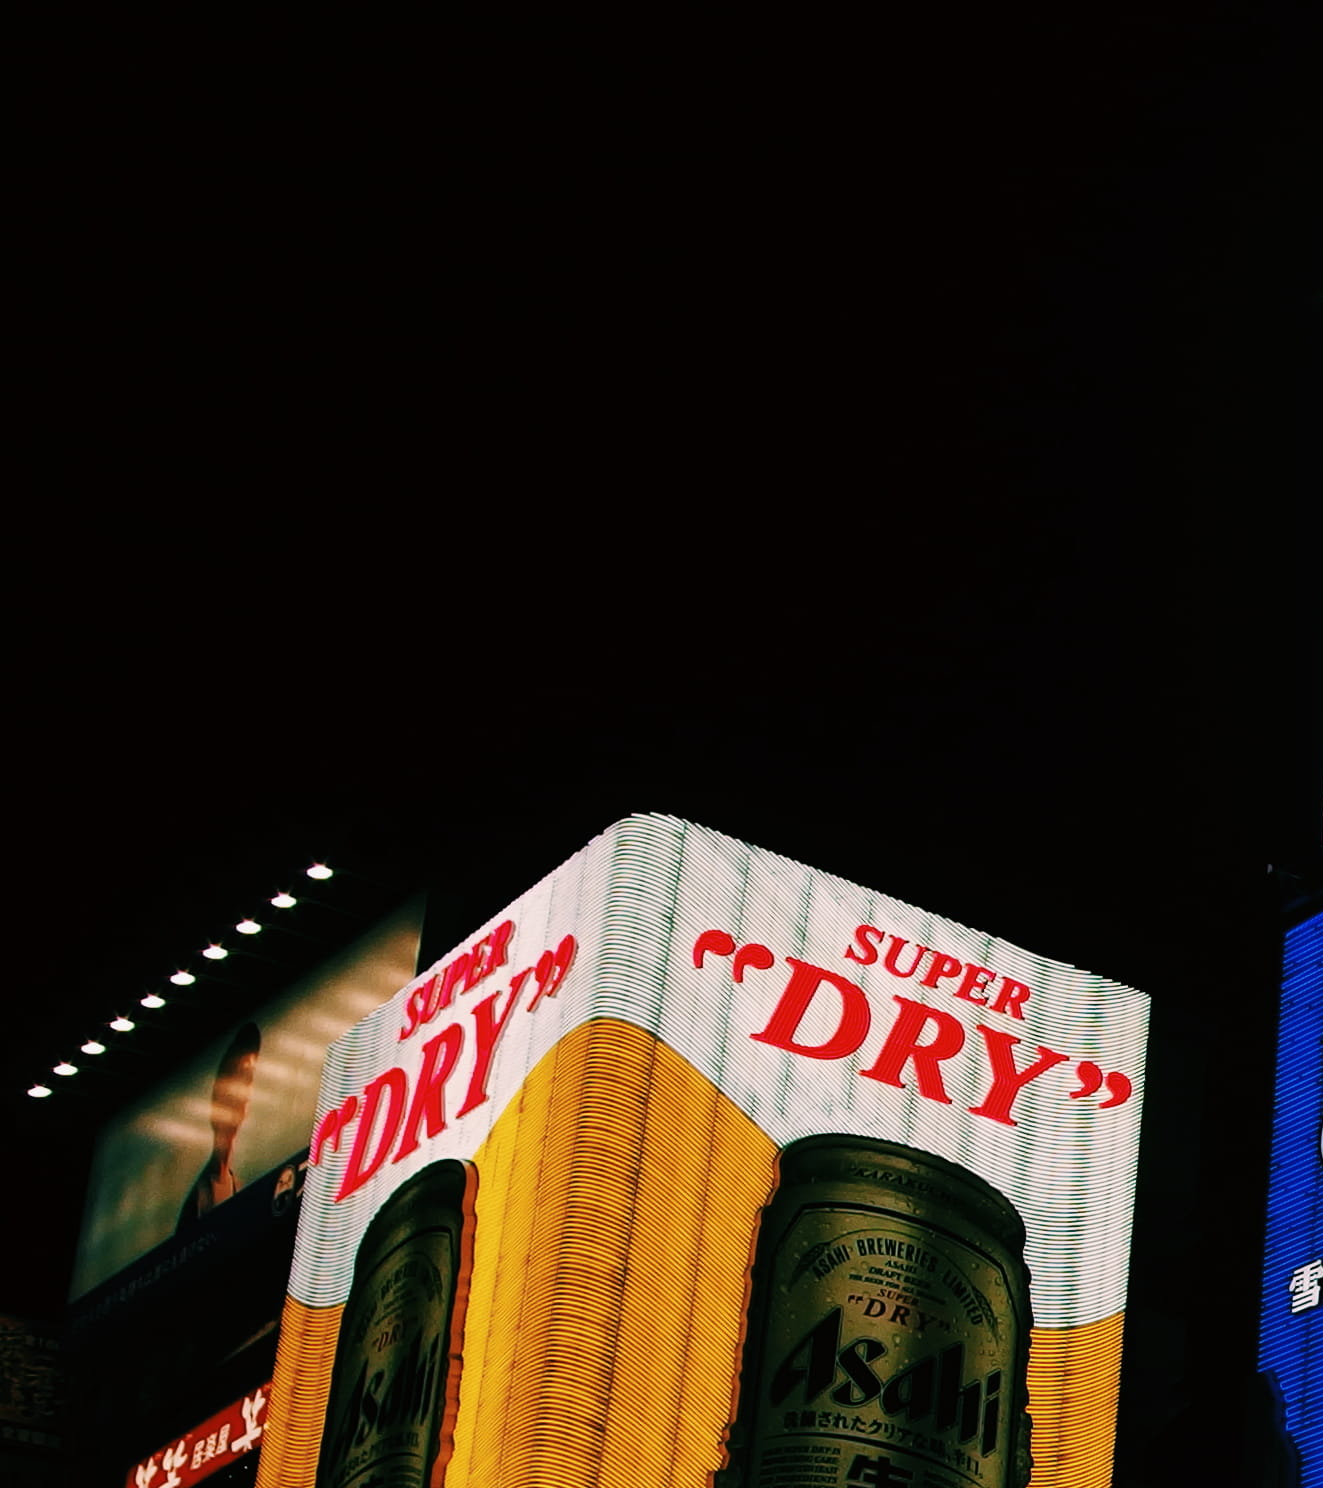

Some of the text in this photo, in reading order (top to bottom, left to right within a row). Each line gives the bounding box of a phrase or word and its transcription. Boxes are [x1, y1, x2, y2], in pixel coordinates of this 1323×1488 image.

[399, 919, 515, 1042] SUPER
[845, 924, 1031, 1021] SUPER
[813, 1248, 850, 1280] ASAHI
[856, 1237, 939, 1273] BREWERIES
[942, 1270, 983, 1326] LIMITED
[770, 1305, 1001, 1459] Asahi
